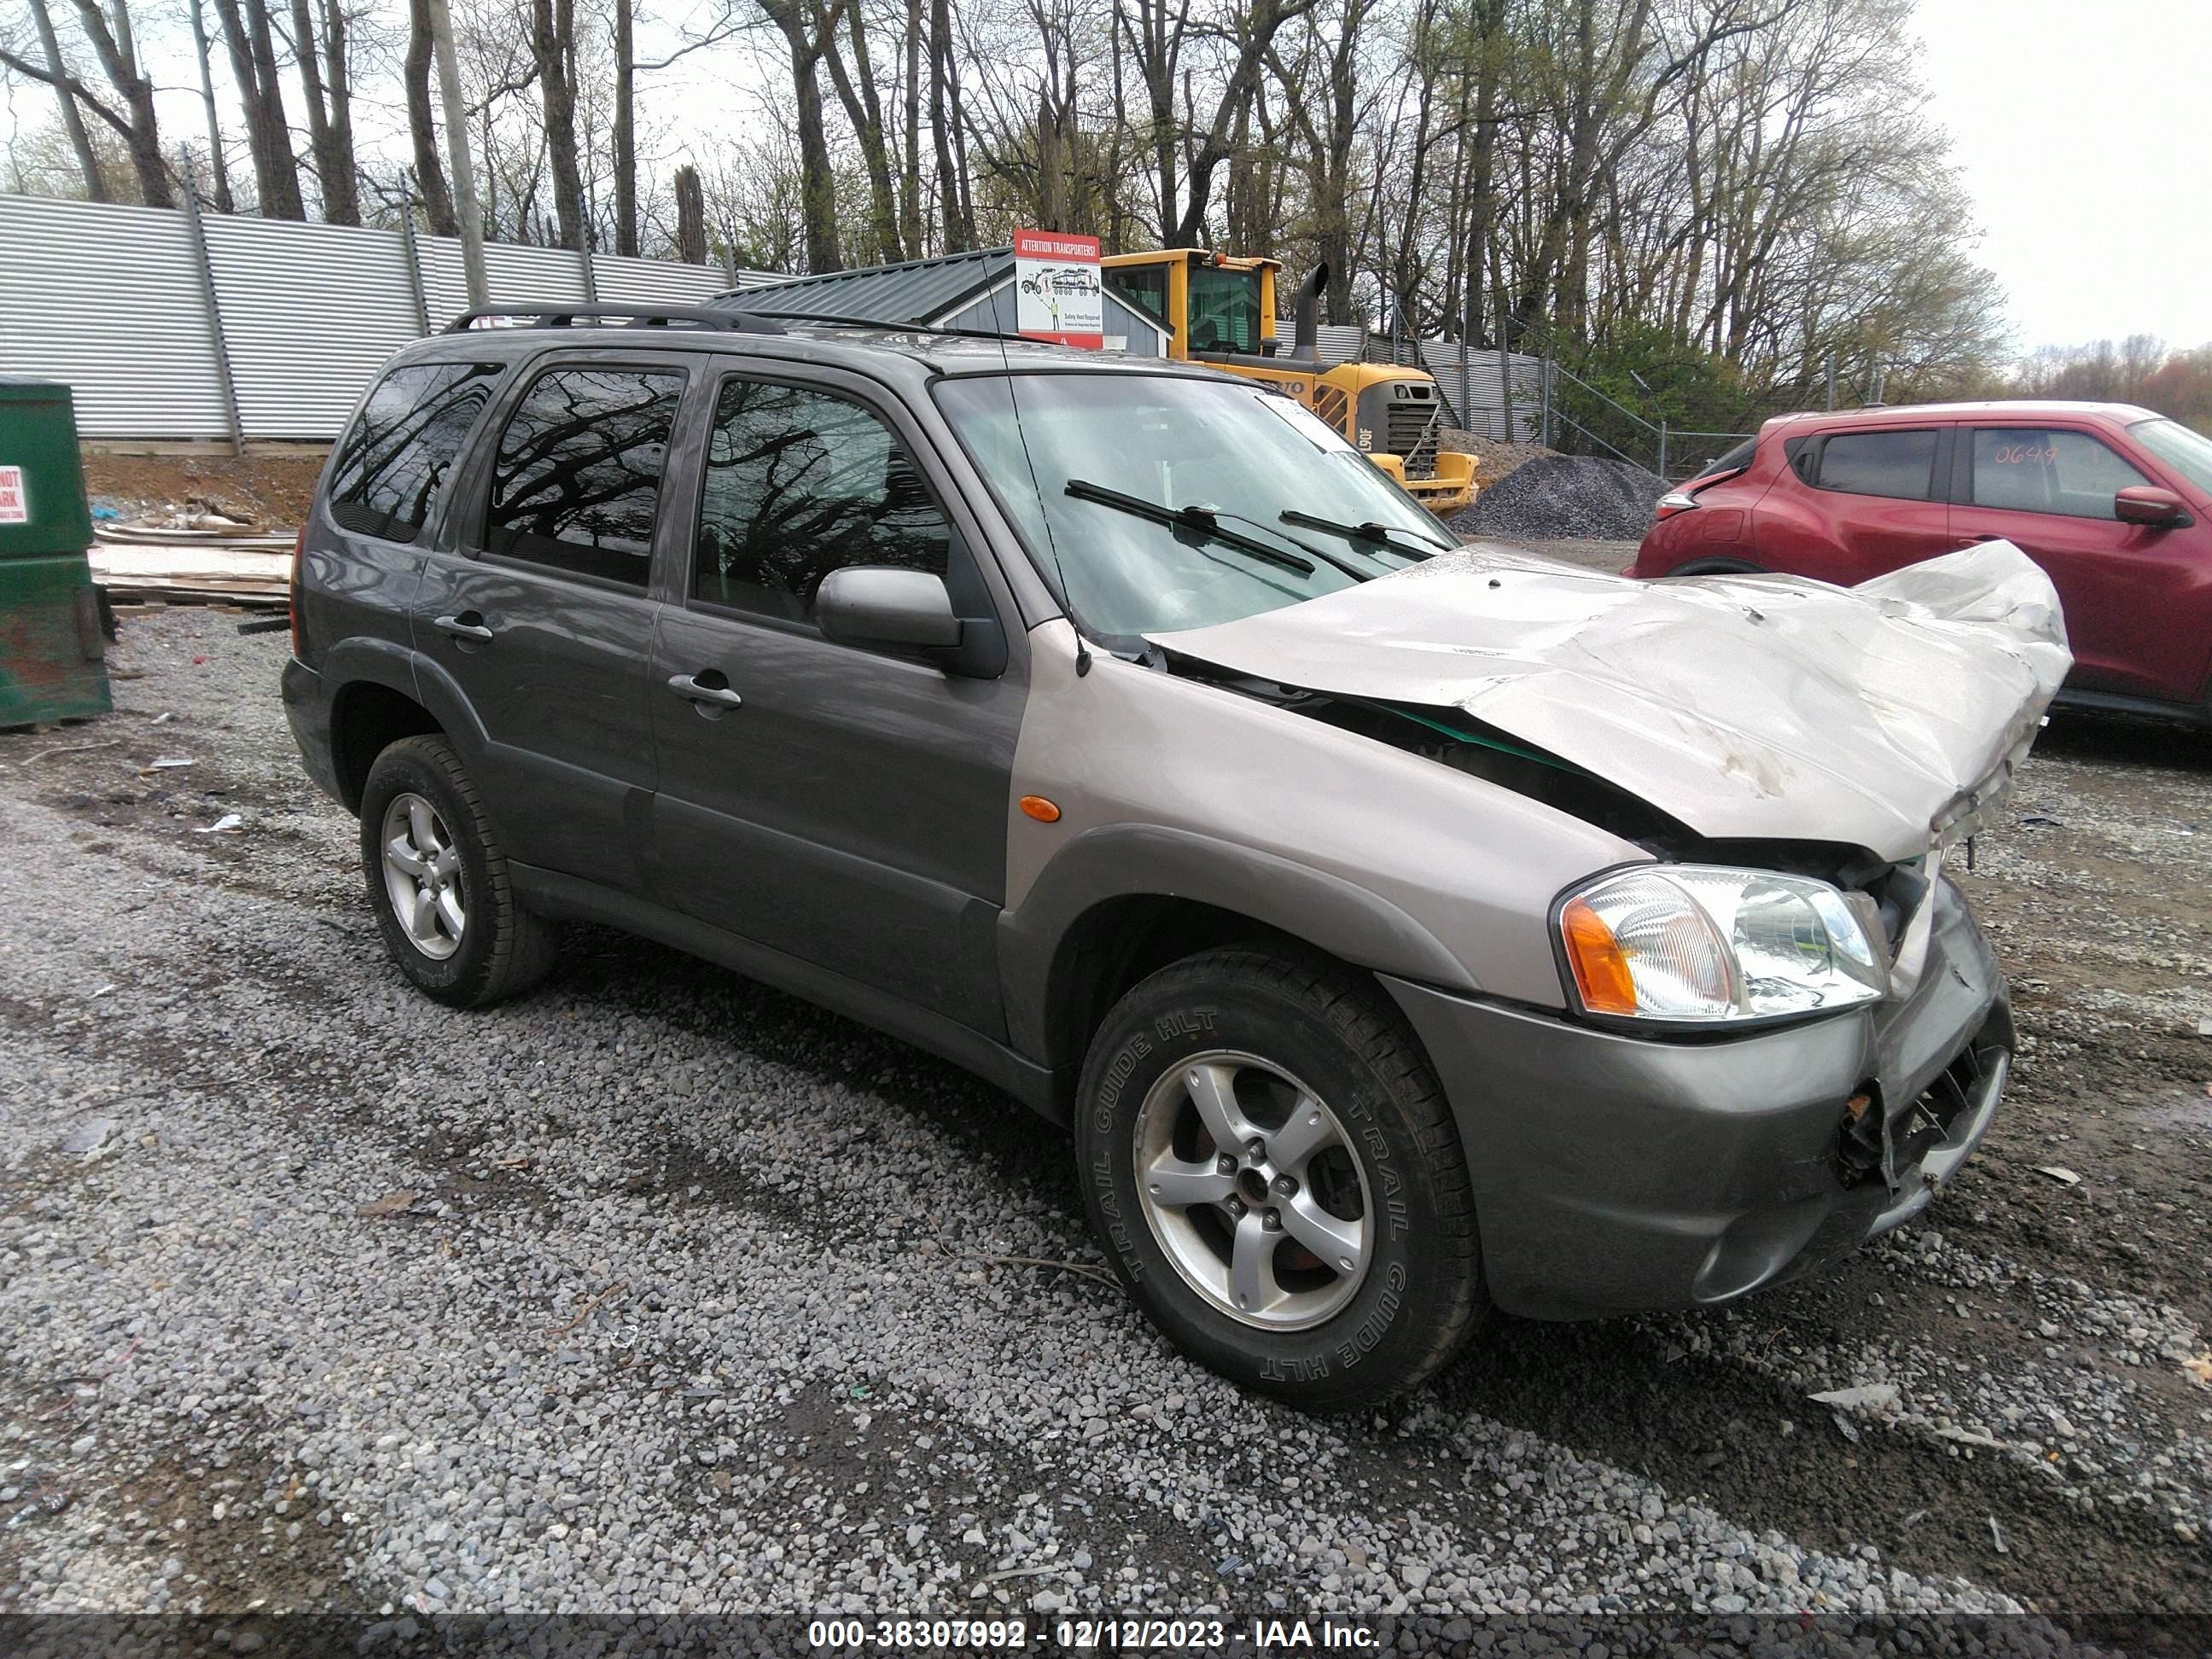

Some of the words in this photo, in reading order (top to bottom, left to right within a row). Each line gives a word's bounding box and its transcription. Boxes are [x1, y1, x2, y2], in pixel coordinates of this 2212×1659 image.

[1022, 239, 1052, 253] ATTENTION
[1053, 242, 1096, 257] TRANSPORTERS!
[1359, 428, 1373, 451] L90F
[0, 491, 18, 507] ARK
[1154, 1009, 1218, 1042] HLT
[1096, 1031, 1153, 1134] GUIDE
[1348, 1093, 1411, 1242] TRAIL
[1092, 1151, 1147, 1284] TRAIL
[1336, 1262, 1407, 1371] GUIDE
[1259, 1354, 1330, 1382] HLT
